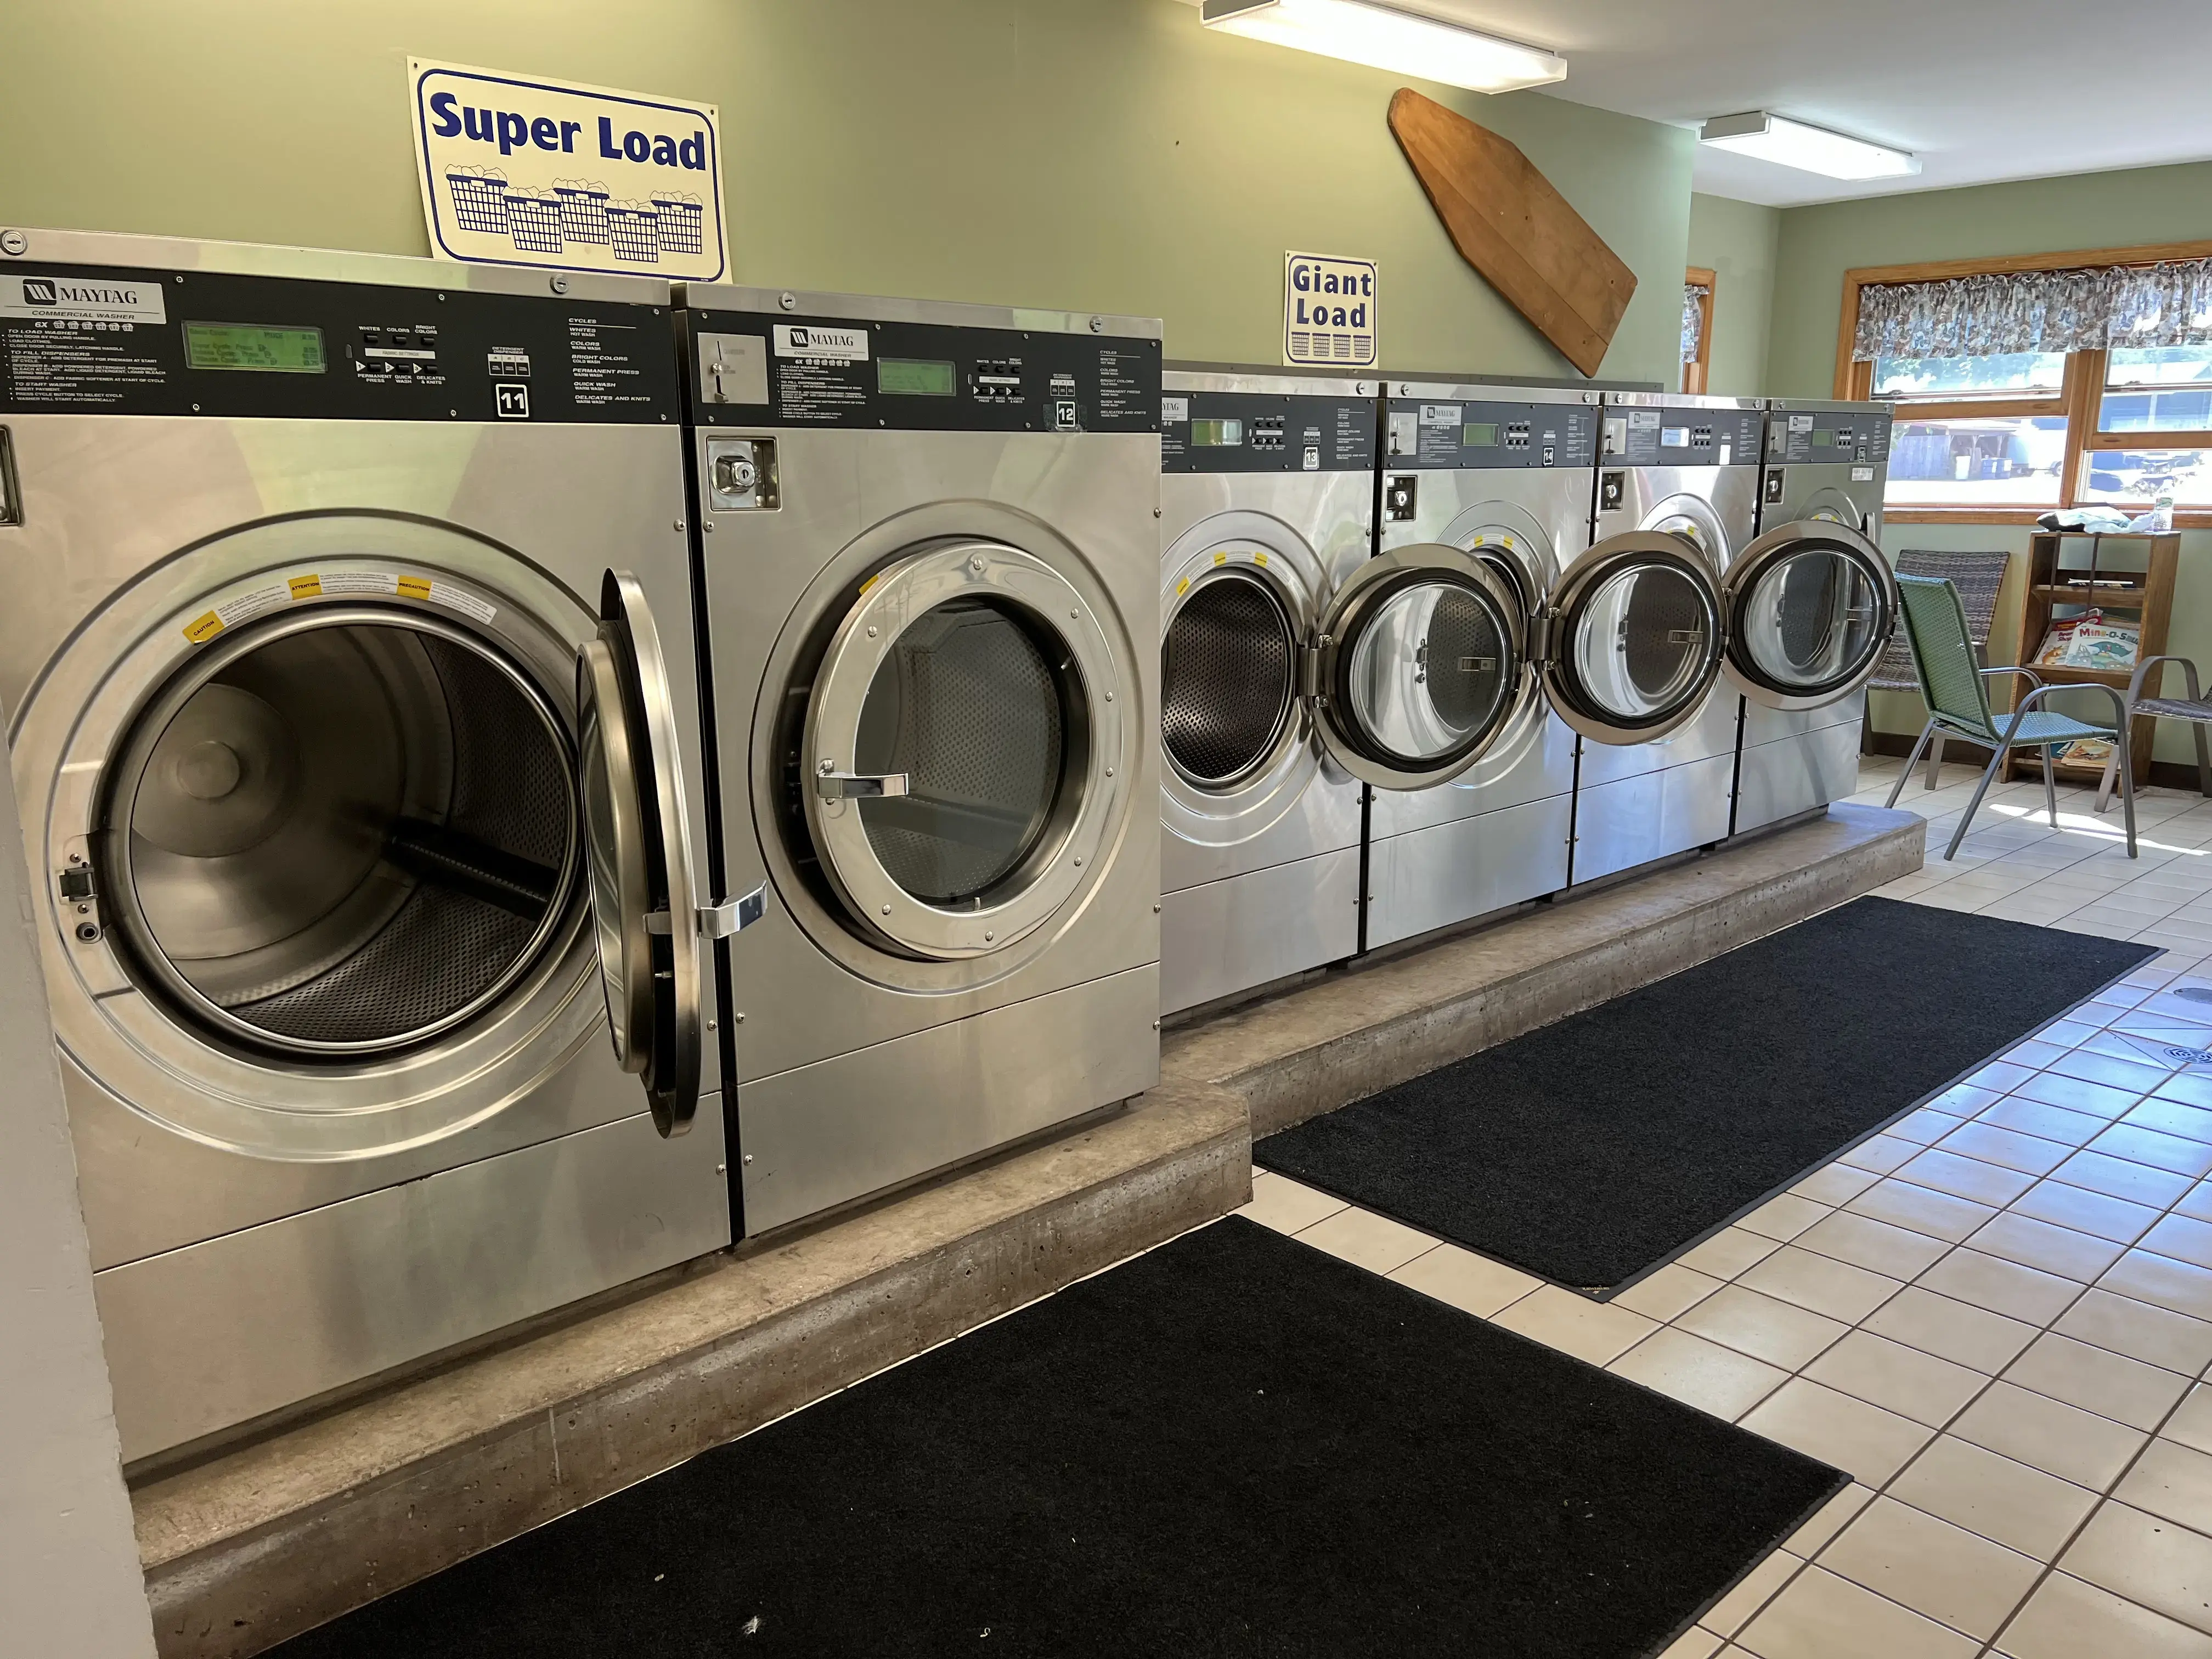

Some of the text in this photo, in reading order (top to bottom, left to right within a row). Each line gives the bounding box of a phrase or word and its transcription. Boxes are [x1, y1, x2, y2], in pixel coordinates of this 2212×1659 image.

[430, 92, 706, 171] Super Load
[1293, 264, 1372, 297] Giant
[60, 287, 137, 304] MAYTAG
[1297, 298, 1365, 328] Load
[811, 334, 854, 346] MAYTAG
[500, 393, 524, 409] 11
[1161, 403, 1179, 411] YTAG
[1059, 408, 1074, 421] 12
[1306, 452, 1316, 462] 13
[1545, 452, 1553, 460] 14
[292, 582, 319, 591] ATTENTION
[399, 583, 430, 591] PRECAUTION
[193, 620, 215, 636] CAUTION
[2079, 628, 2138, 645] Mine-O-Sau
